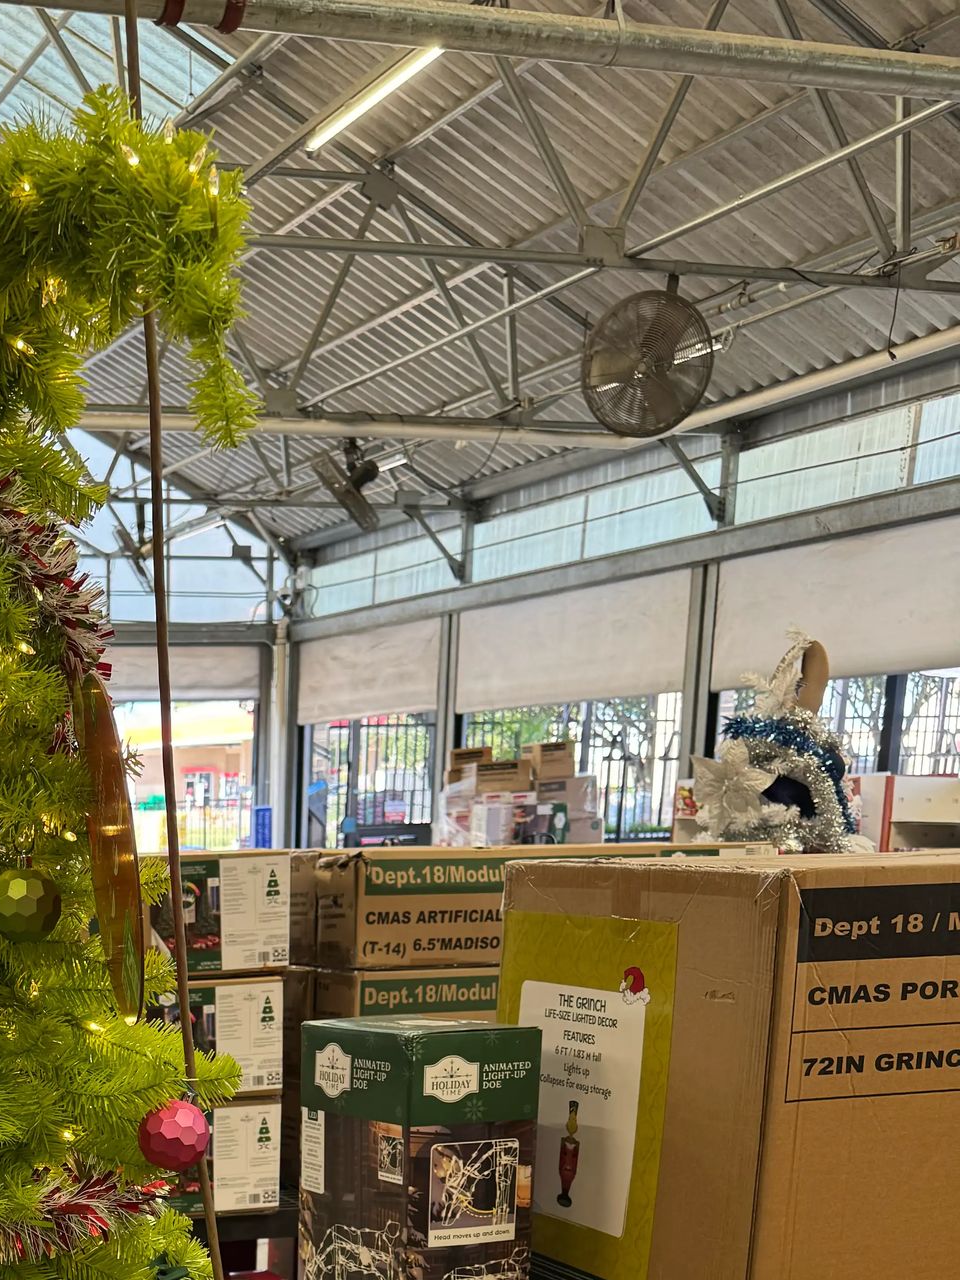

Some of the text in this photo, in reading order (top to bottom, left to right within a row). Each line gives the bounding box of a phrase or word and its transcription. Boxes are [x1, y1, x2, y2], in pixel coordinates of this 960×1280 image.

[366, 909, 502, 924] CMAS ARTIFICIAL
[814, 916, 880, 940] Dept
[891, 914, 924, 933] 18
[932, 912, 940, 932] /
[362, 942, 406, 958] (T-14)
[808, 980, 959, 1005] CMAS POR
[559, 994, 606, 1013] THE GRINCH
[544, 1008, 618, 1028] LIFE-SIZE LIGHTED DECOR
[563, 1030, 596, 1044] FEATURES
[555, 1046, 560, 1054] 6
[560, 1047, 568, 1056] FT
[592, 1052, 602, 1062] tall
[354, 1058, 391, 1072] ANIMATED
[482, 1061, 532, 1072] ANIMATED
[803, 1049, 960, 1076] 72IN GRINC
[320, 1070, 346, 1084] HOLIDAY
[353, 1068, 386, 1082] LIGHT-UP
[482, 1070, 526, 1080] LIGHT-UP
[564, 1062, 590, 1079] Lights up
[326, 1082, 339, 1090] TIME
[353, 1080, 368, 1090] DOE
[432, 1080, 472, 1090] HOLIDAY
[482, 1080, 502, 1089] DOE
[540, 1074, 612, 1100] Collapses for easy storage
